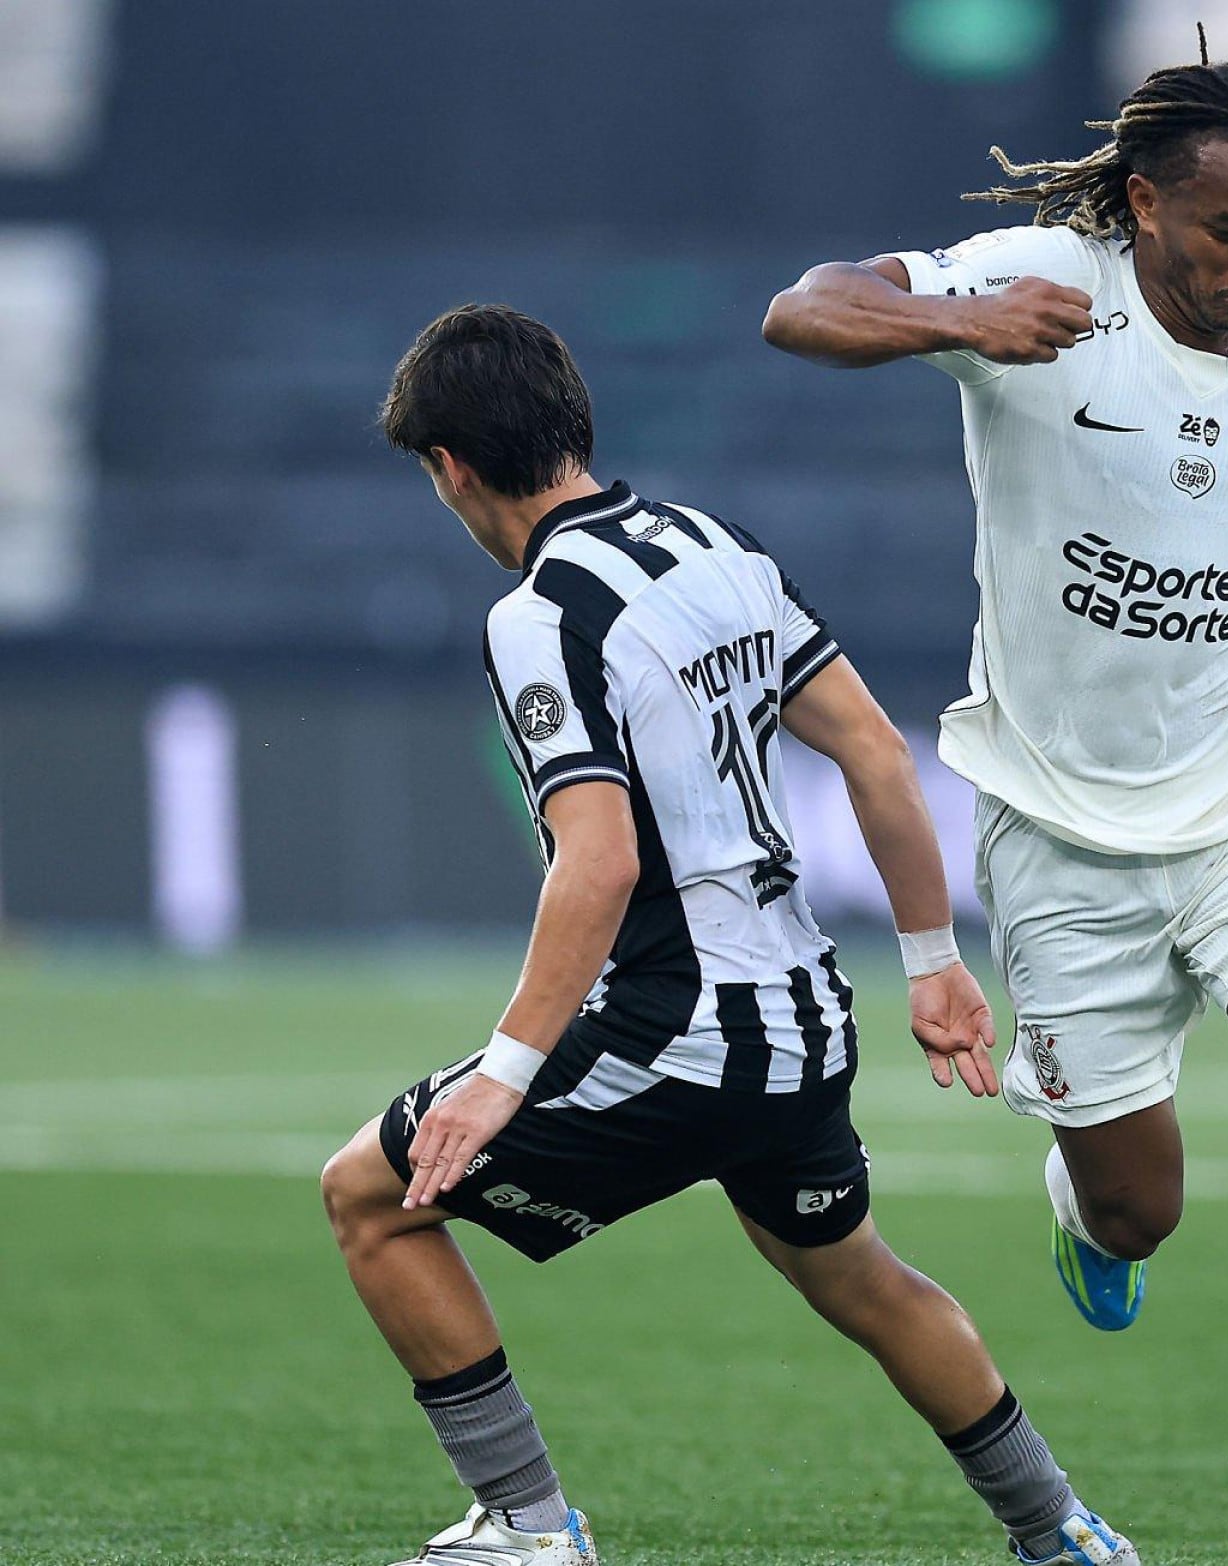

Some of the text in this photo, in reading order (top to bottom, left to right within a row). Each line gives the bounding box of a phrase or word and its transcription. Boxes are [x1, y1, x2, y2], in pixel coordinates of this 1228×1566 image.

[1179, 413, 1202, 436] Zé
[1177, 433, 1201, 444] DELIVERY
[1176, 472, 1211, 489] Legal
[626, 515, 677, 543] Reebok
